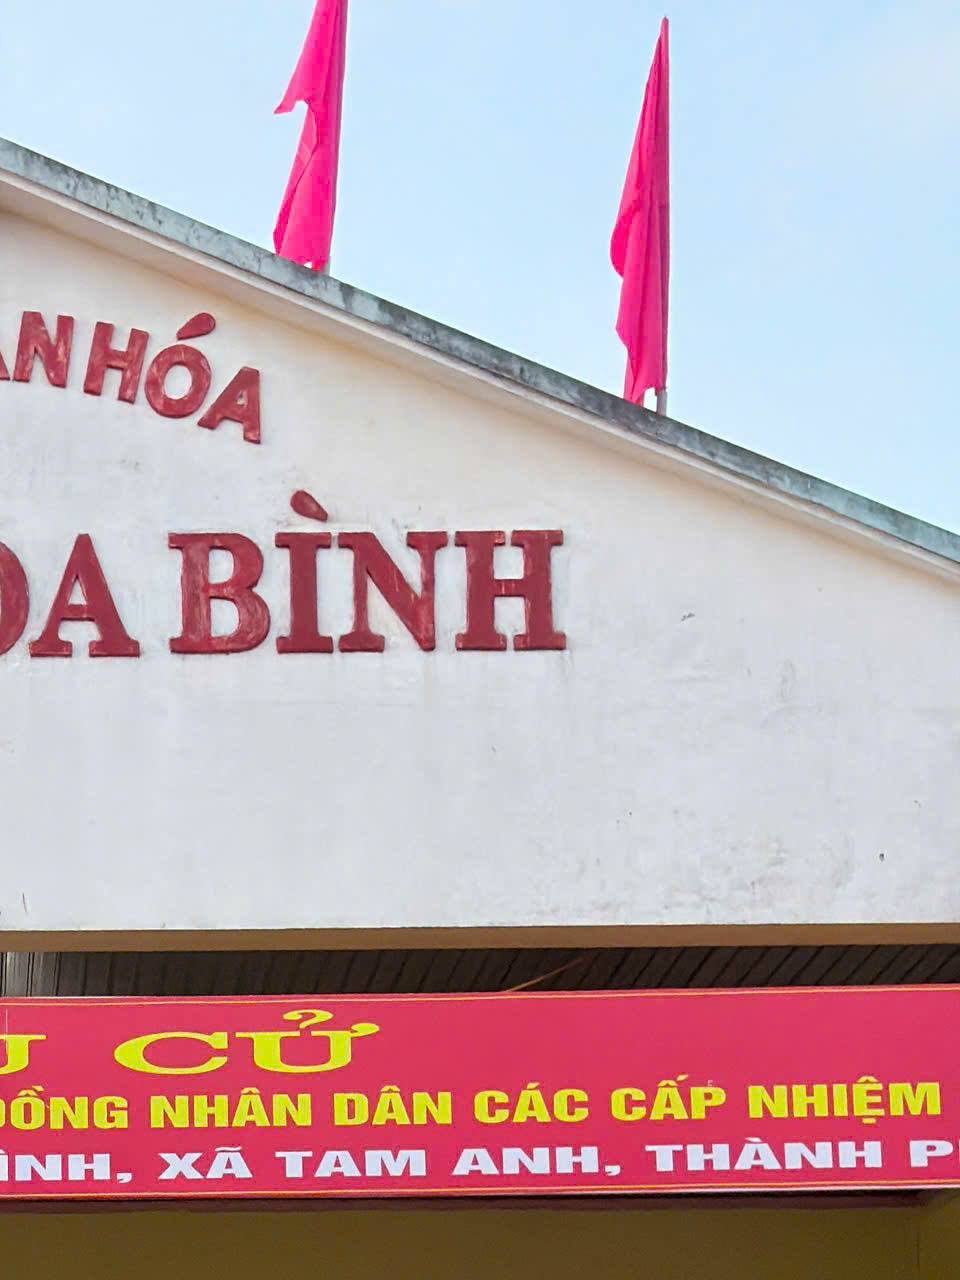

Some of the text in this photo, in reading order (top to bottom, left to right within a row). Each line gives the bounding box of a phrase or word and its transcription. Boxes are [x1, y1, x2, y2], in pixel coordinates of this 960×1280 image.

[83, 312, 262, 445] HÓA
[167, 489, 568, 655] BÌNH
[113, 1009, 380, 1075] CỬ
[150, 1087, 312, 1128] NHÂN
[333, 1085, 452, 1126] DÂN
[474, 1082, 589, 1124] CÁC
[610, 1074, 726, 1121] CẤP
[747, 1075, 941, 1124] NHIỆM
[158, 1146, 253, 1180] XÃ
[275, 1149, 427, 1178] TAM
[451, 1145, 621, 1176] ANH,
[645, 1137, 883, 1172] THÀNH
[909, 1139, 960, 1168] P
